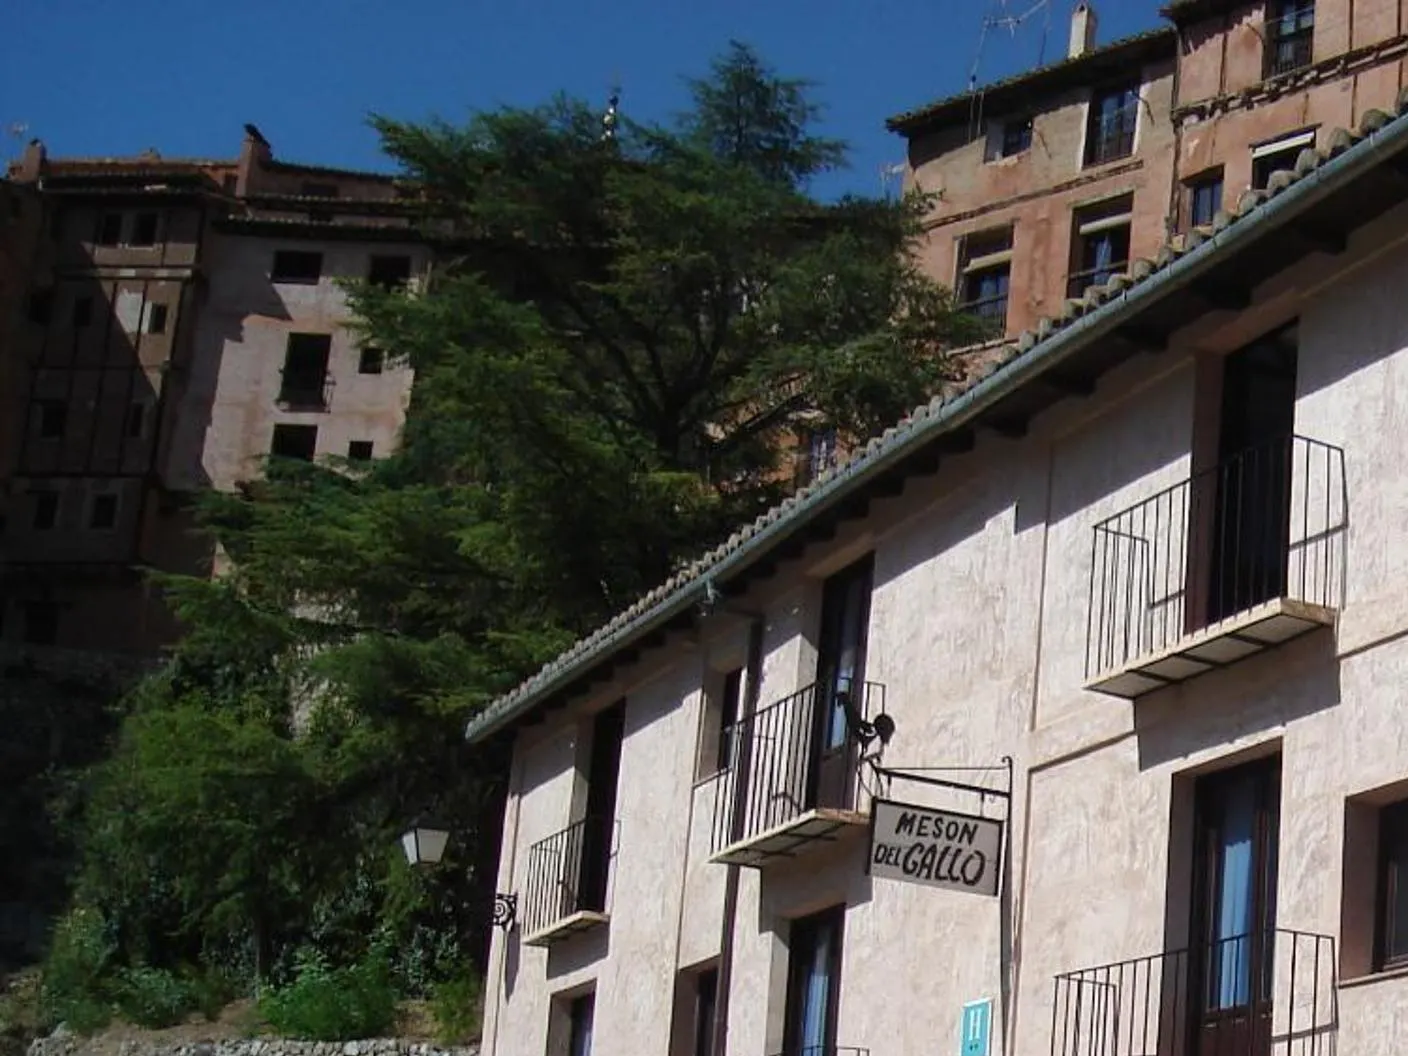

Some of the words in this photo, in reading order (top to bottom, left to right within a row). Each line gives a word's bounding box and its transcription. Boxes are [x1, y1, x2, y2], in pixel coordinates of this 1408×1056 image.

[895, 811, 979, 846] MESON
[873, 843, 900, 867] DEL
[902, 842, 986, 887] GALLO
